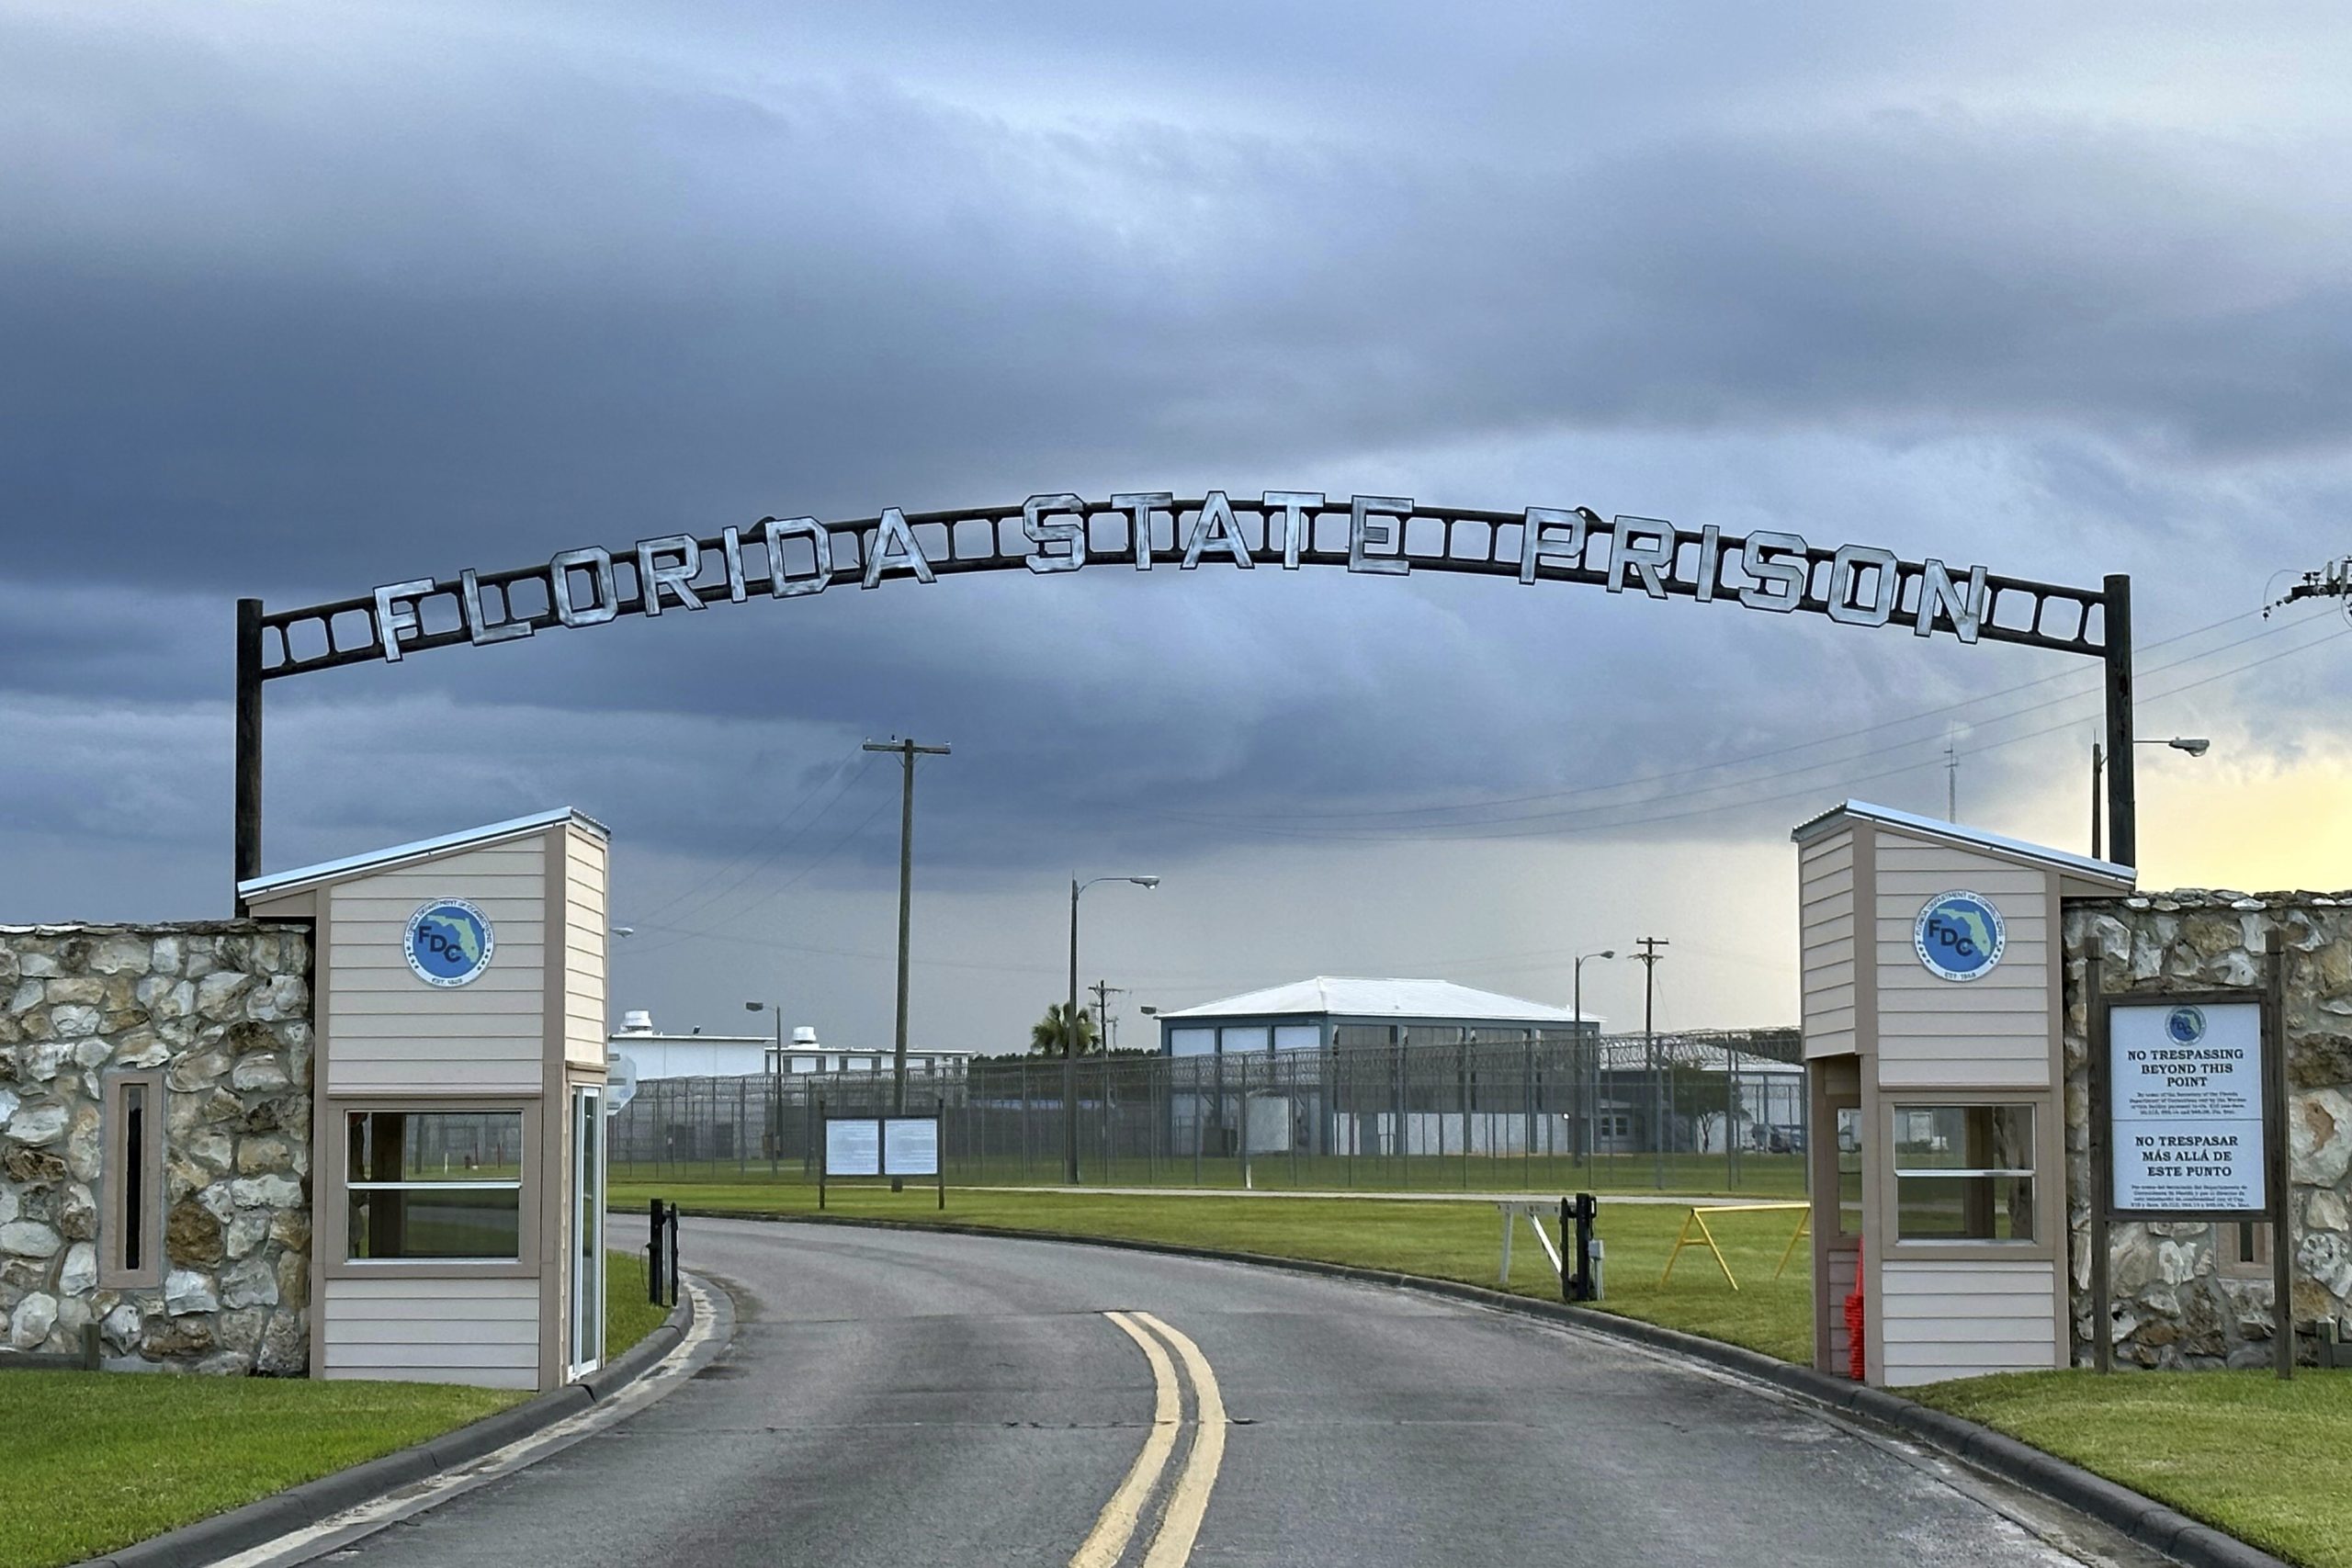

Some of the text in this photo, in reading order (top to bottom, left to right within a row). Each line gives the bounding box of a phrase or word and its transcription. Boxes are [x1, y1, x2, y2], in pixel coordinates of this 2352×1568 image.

[372, 491, 1988, 662] FLORIDA STATE PRISON
[1928, 919, 1973, 957] FDC
[418, 926, 462, 964] FDC
[2127, 1049, 2244, 1061] NO TRESPASSING
[2141, 1063, 2233, 1075] BEYOND THIS
[2167, 1077, 2208, 1088] POINT
[2135, 1135, 2238, 1146] NO TRESPASAR
[2142, 1149, 2233, 1162] MÁS ALLÁ DE
[2147, 1167, 2232, 1177] ESTE PUNTO
